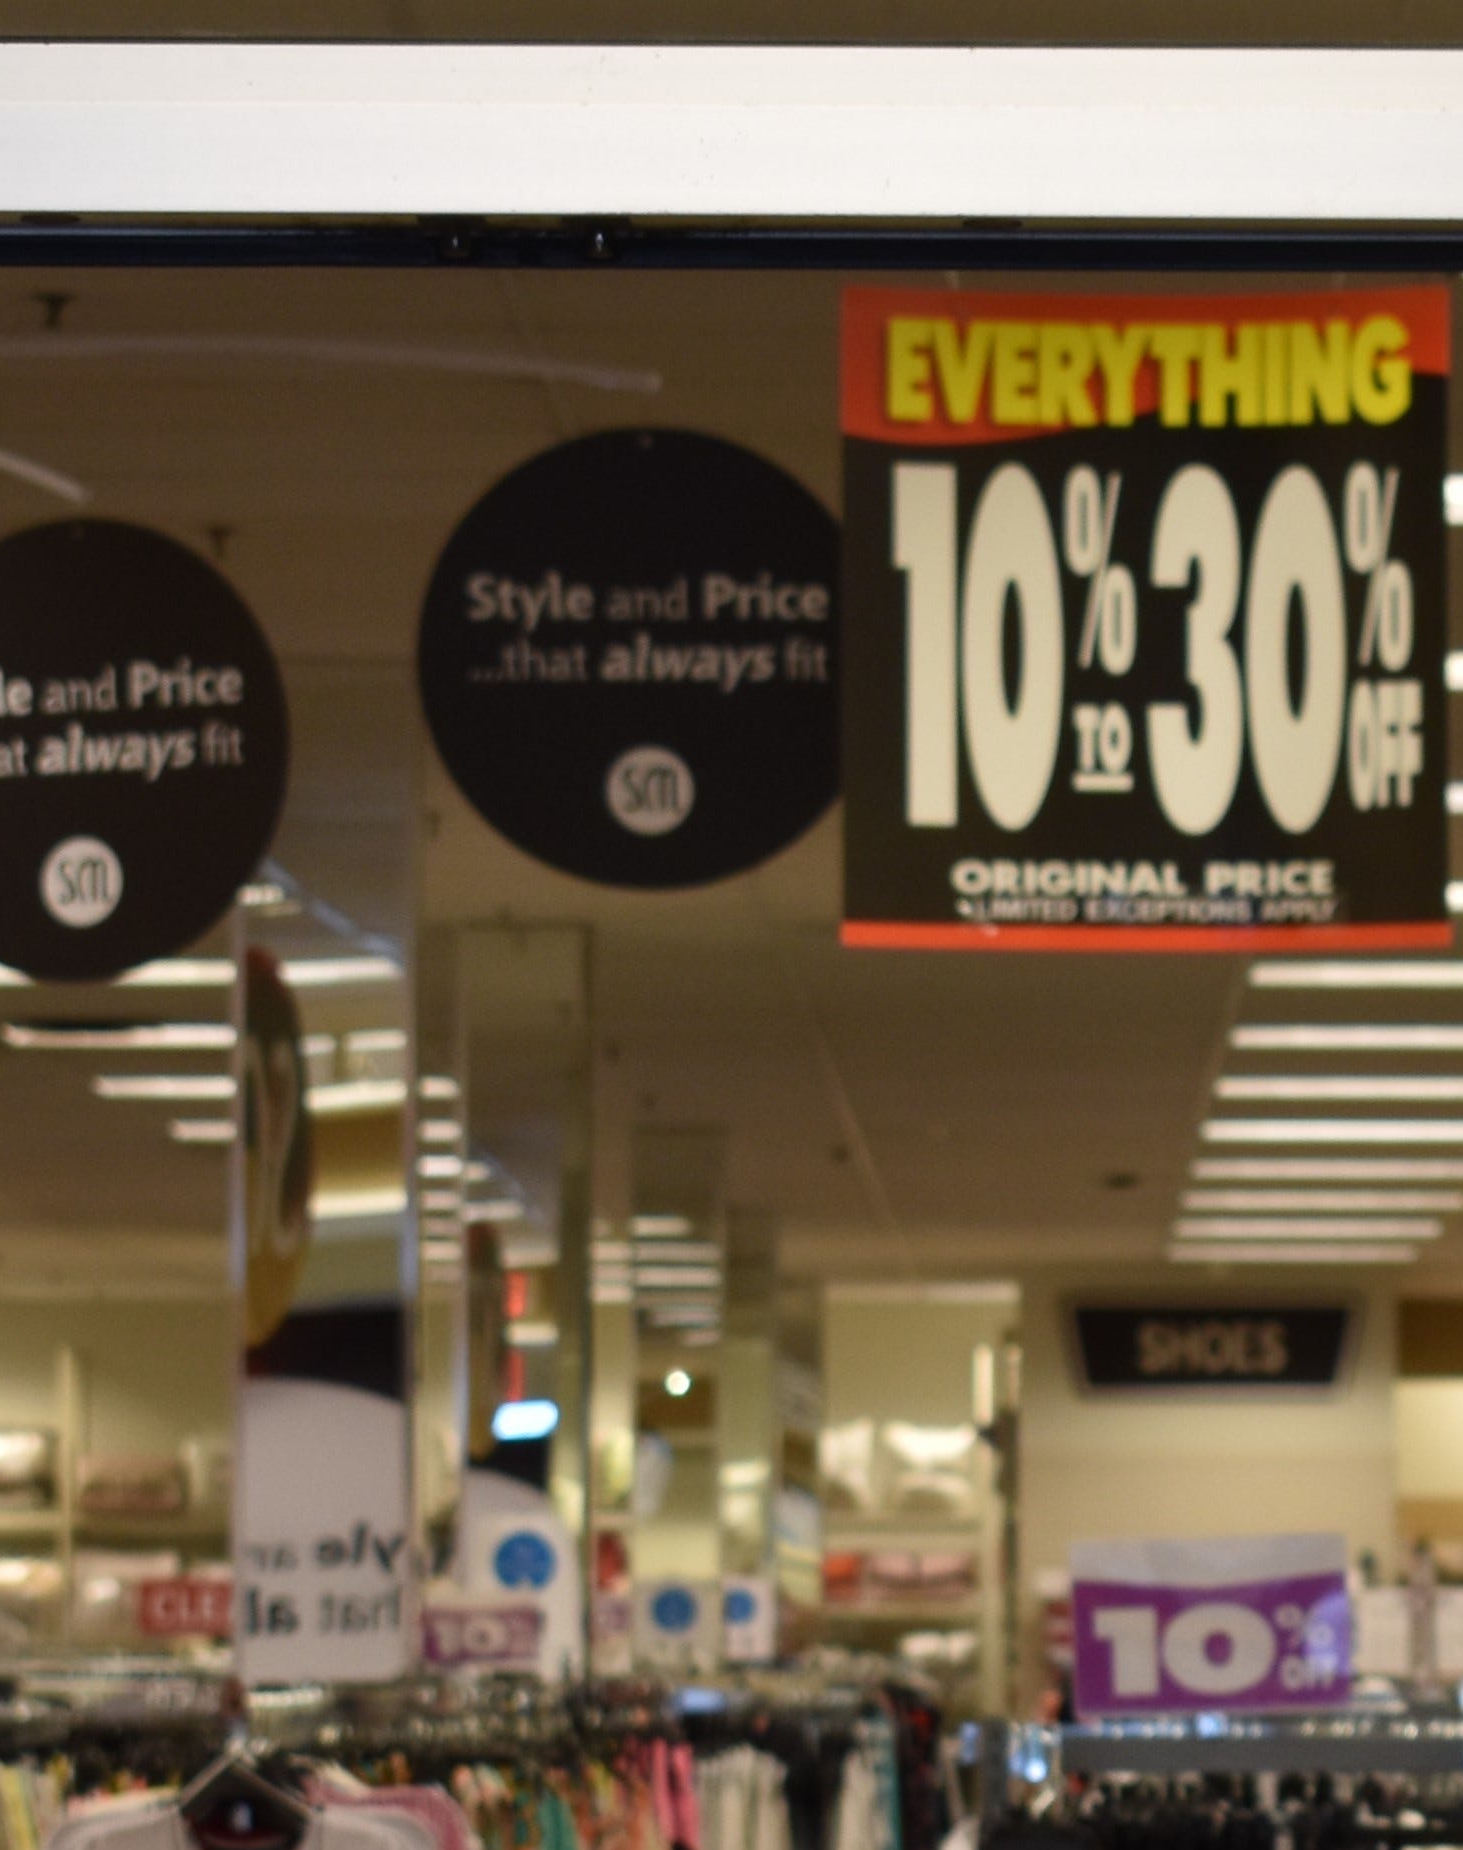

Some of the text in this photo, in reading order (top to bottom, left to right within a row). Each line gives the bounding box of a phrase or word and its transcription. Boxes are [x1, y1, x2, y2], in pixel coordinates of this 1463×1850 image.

[888, 316, 1413, 426] EVERYTHING
[466, 572, 830, 633] Style and Price
[44, 663, 118, 712] and
[127, 656, 243, 708] Price
[601, 635, 775, 694] always
[784, 637, 829, 682] fit
[37, 725, 196, 783] always
[202, 721, 243, 766] fit
[1074, 706, 1135, 793] TO
[1347, 679, 1424, 812] OFF
[949, 858, 1335, 896] ORIGINAL PRICE
[1138, 1321, 1290, 1375] SHOES
